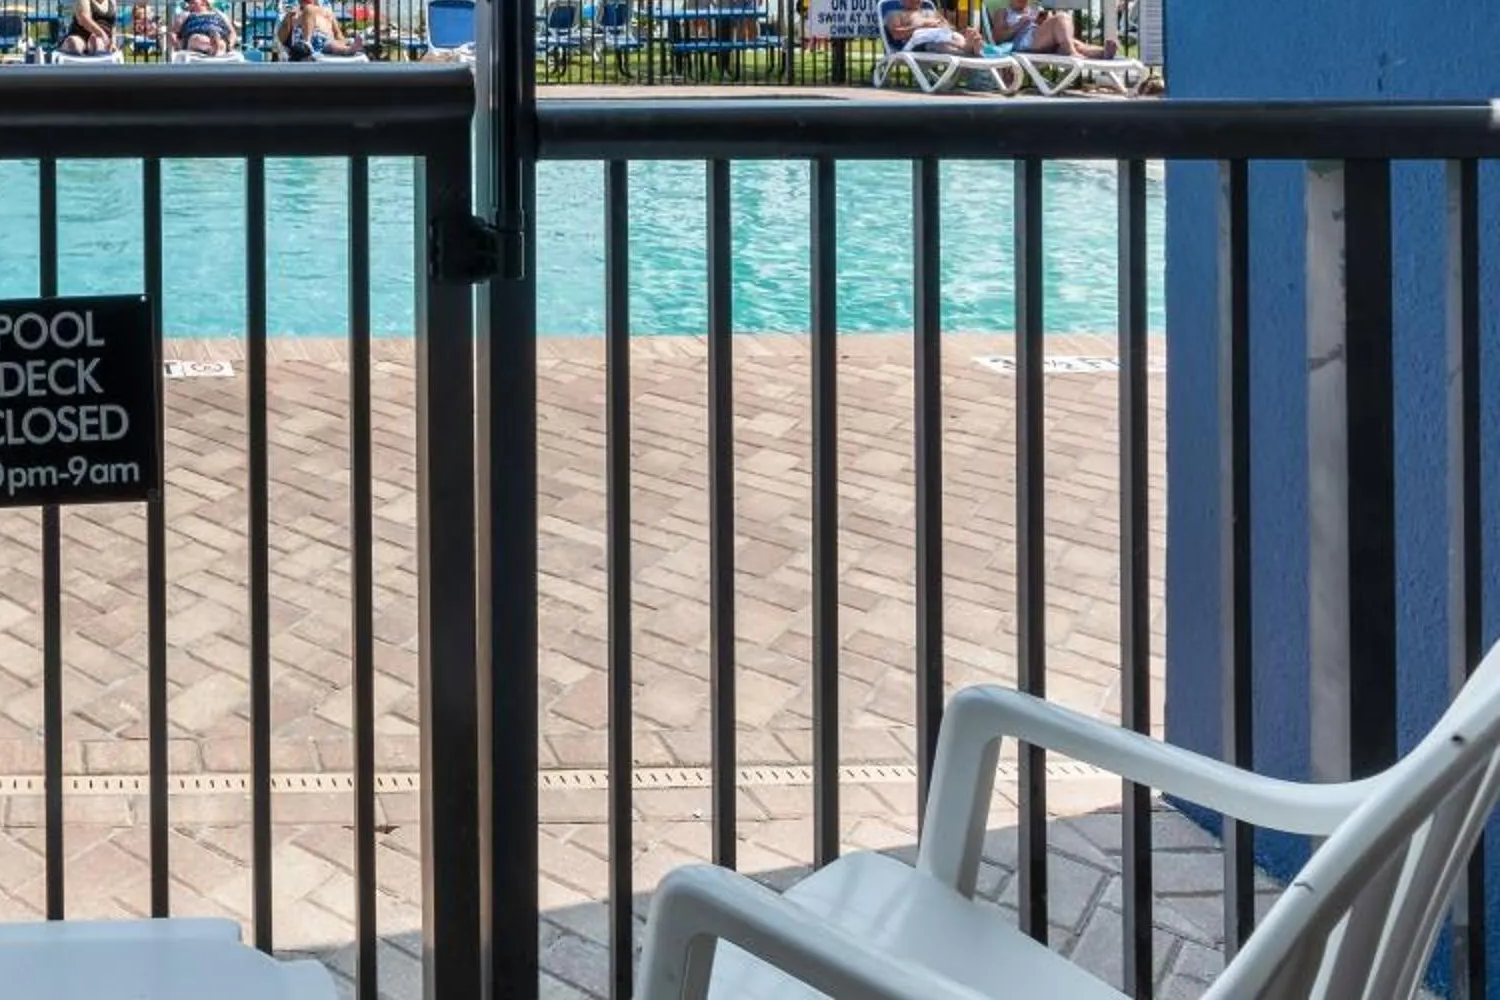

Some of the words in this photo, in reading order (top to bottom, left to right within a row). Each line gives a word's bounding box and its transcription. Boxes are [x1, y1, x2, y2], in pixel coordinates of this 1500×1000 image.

[817, 12, 846, 23] SWIM
[849, 12, 861, 23] AT
[865, 12, 879, 23] YO
